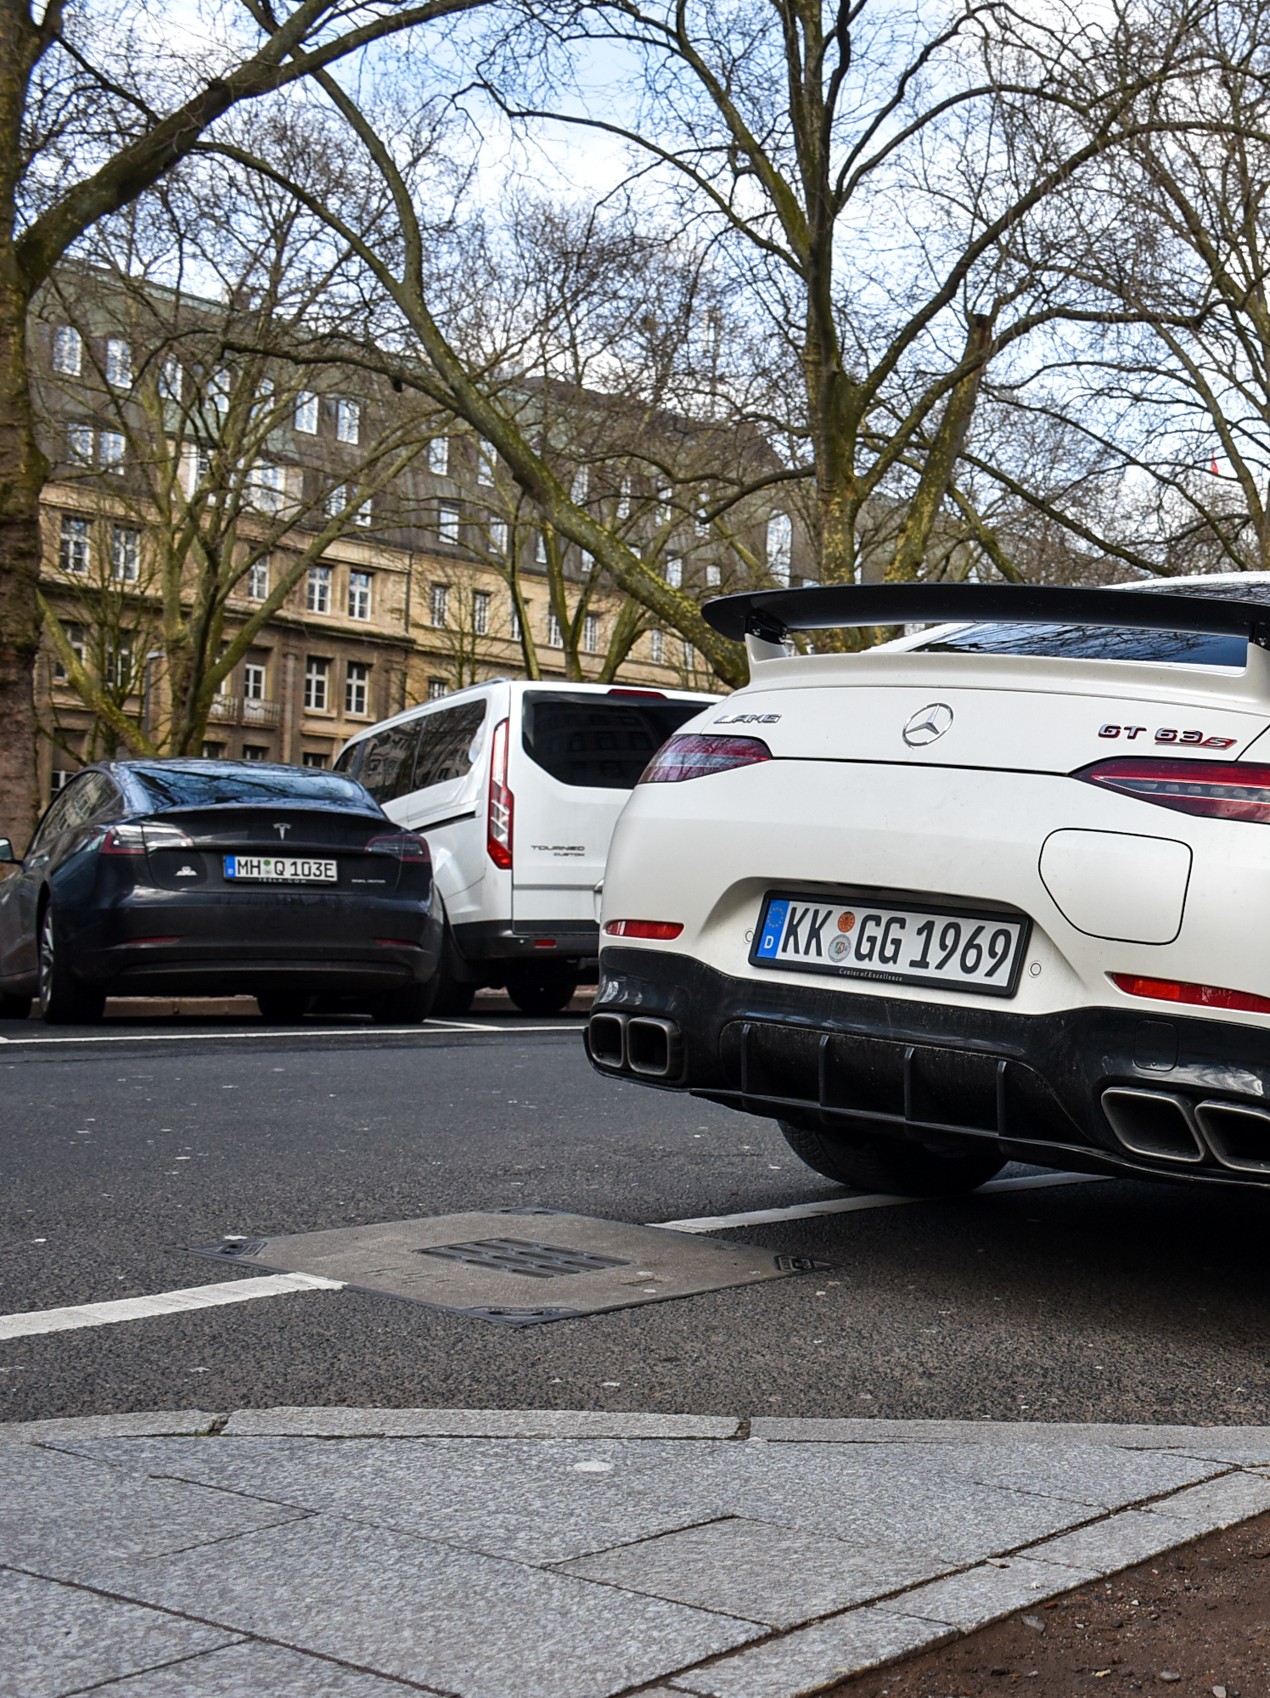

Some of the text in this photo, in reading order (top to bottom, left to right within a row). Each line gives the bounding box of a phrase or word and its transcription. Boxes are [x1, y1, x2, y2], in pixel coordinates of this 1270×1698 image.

[727, 713, 782, 724] AMG
[1098, 723, 1147, 740] GT
[237, 859, 262, 876] MH
[273, 860, 286, 876] Q
[290, 861, 335, 879] 103E
[764, 906, 1012, 977] D KK GG 1969
[839, 968, 859, 976] Center
[868, 972, 903, 981] Excellence
